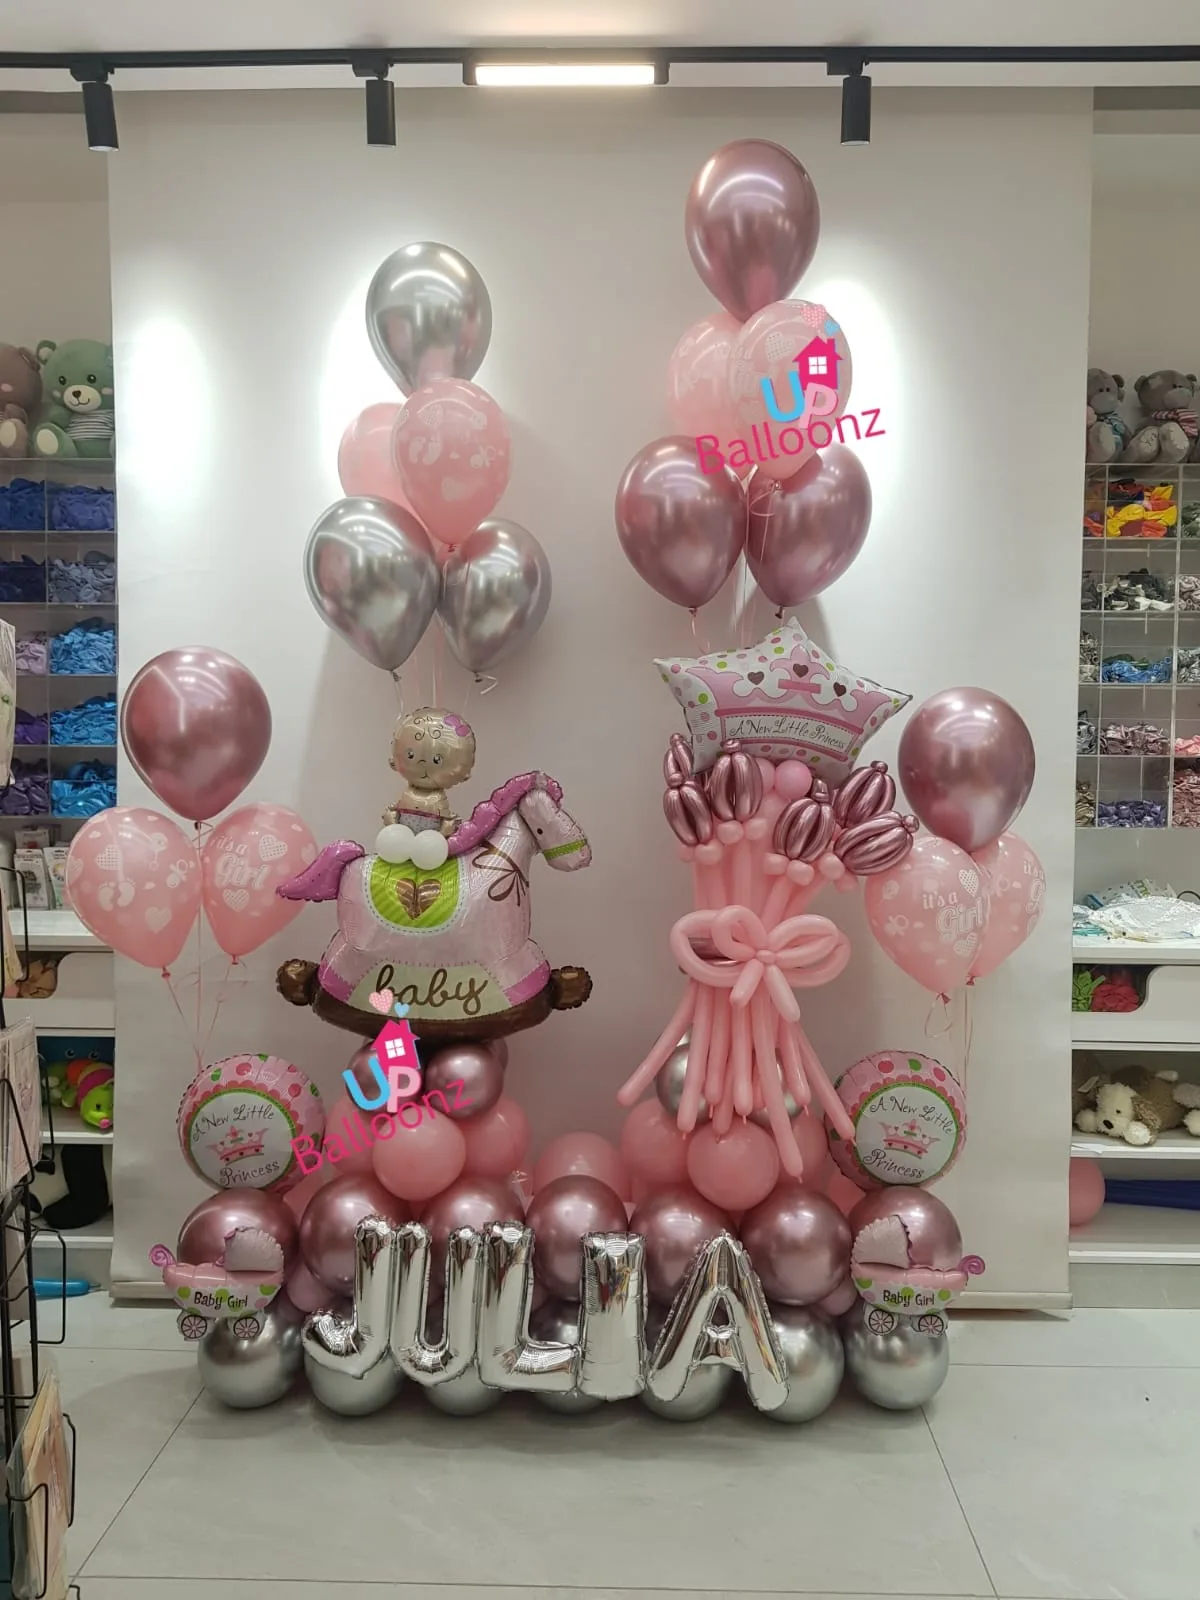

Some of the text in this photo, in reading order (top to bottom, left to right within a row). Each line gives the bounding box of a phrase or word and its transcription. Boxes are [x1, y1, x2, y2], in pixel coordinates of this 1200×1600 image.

[729, 717, 846, 750] A New Little Princess
[215, 852, 271, 890] Girl
[936, 897, 983, 935] Girl
[375, 964, 489, 1016] baby
[193, 1103, 275, 1142] A New Little
[869, 1095, 954, 1134] A New Little
[219, 1160, 281, 1186] Princess
[863, 1148, 925, 1179] Princess
[194, 1291, 249, 1311] Baby Girl
[303, 1213, 790, 1412] JULIA
[883, 1289, 935, 1308] Baby Girl
